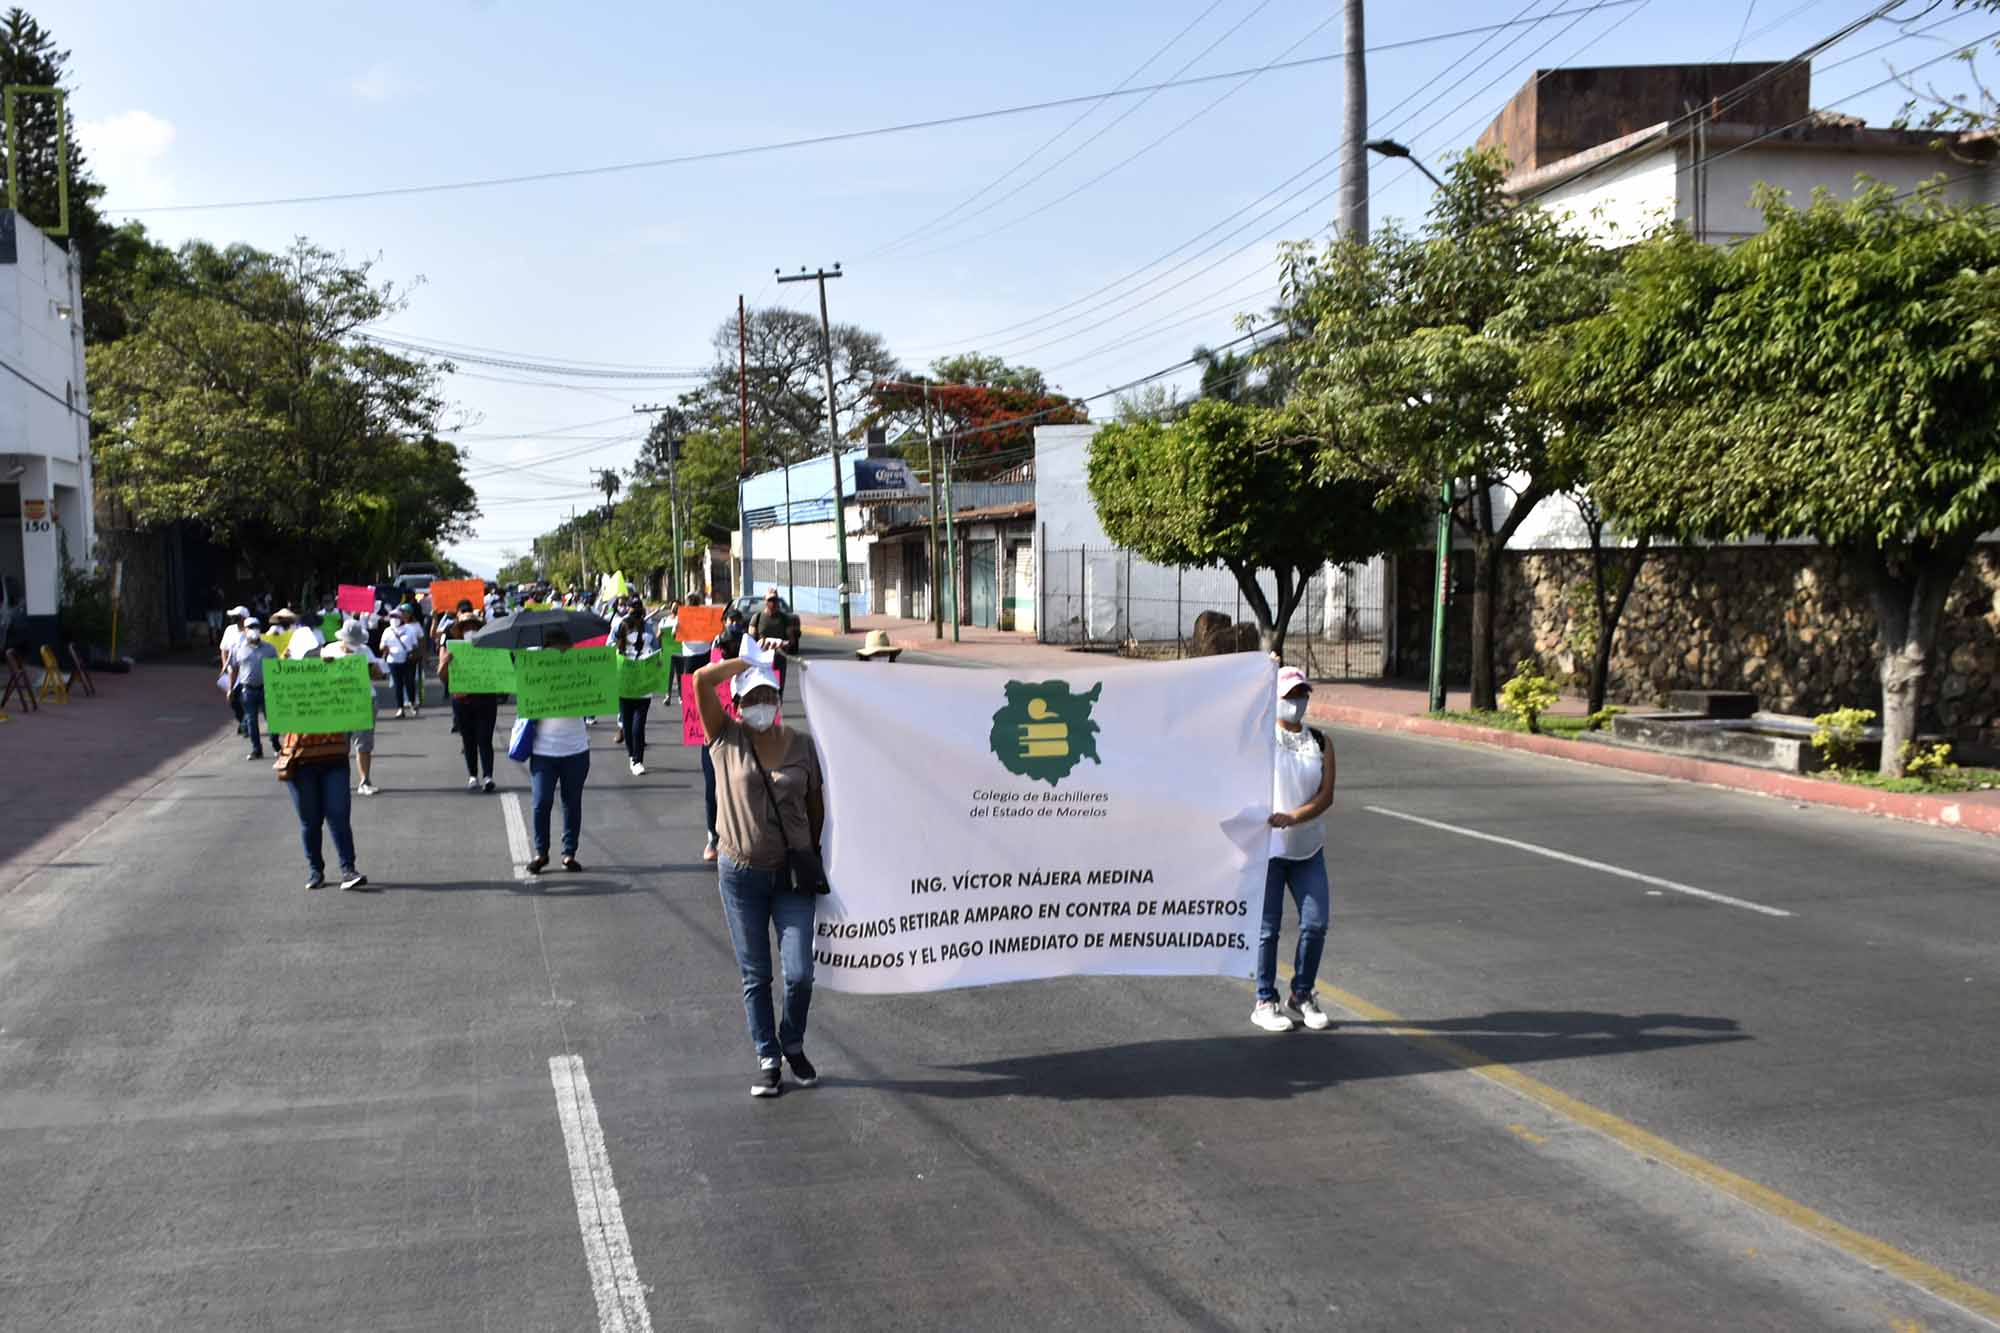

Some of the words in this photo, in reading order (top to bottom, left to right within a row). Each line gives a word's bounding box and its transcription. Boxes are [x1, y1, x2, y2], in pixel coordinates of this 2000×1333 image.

[25, 521, 50, 532] 150
[972, 789, 1020, 803] Colegio
[1022, 791, 1040, 802] de
[1042, 791, 1109, 803] Bachilleres
[969, 806, 990, 818] del
[992, 806, 1034, 818] Estado
[1036, 806, 1053, 818] de
[1056, 807, 1107, 818] Morelos
[910, 877, 947, 895] ING.
[952, 870, 1013, 891] VÍCTOR
[1018, 867, 1082, 887] NÁJERA
[1087, 869, 1154, 886] MEDINA
[817, 917, 897, 939] EXIGIMOS
[900, 908, 960, 933] RETIRAR
[964, 904, 1034, 925] AMPARO
[1038, 903, 1061, 918] EN
[1065, 902, 1132, 918] CONTRA
[1136, 901, 1158, 916] DE
[1162, 900, 1248, 917] MAESTROS
[908, 950, 919, 966] Y
[922, 946, 937, 965] EL
[941, 940, 984, 961] PAGO
[988, 933, 1079, 955] INMEDIATO
[1083, 932, 1105, 949] DE
[1109, 931, 1250, 951] MENSUALIDADES.
